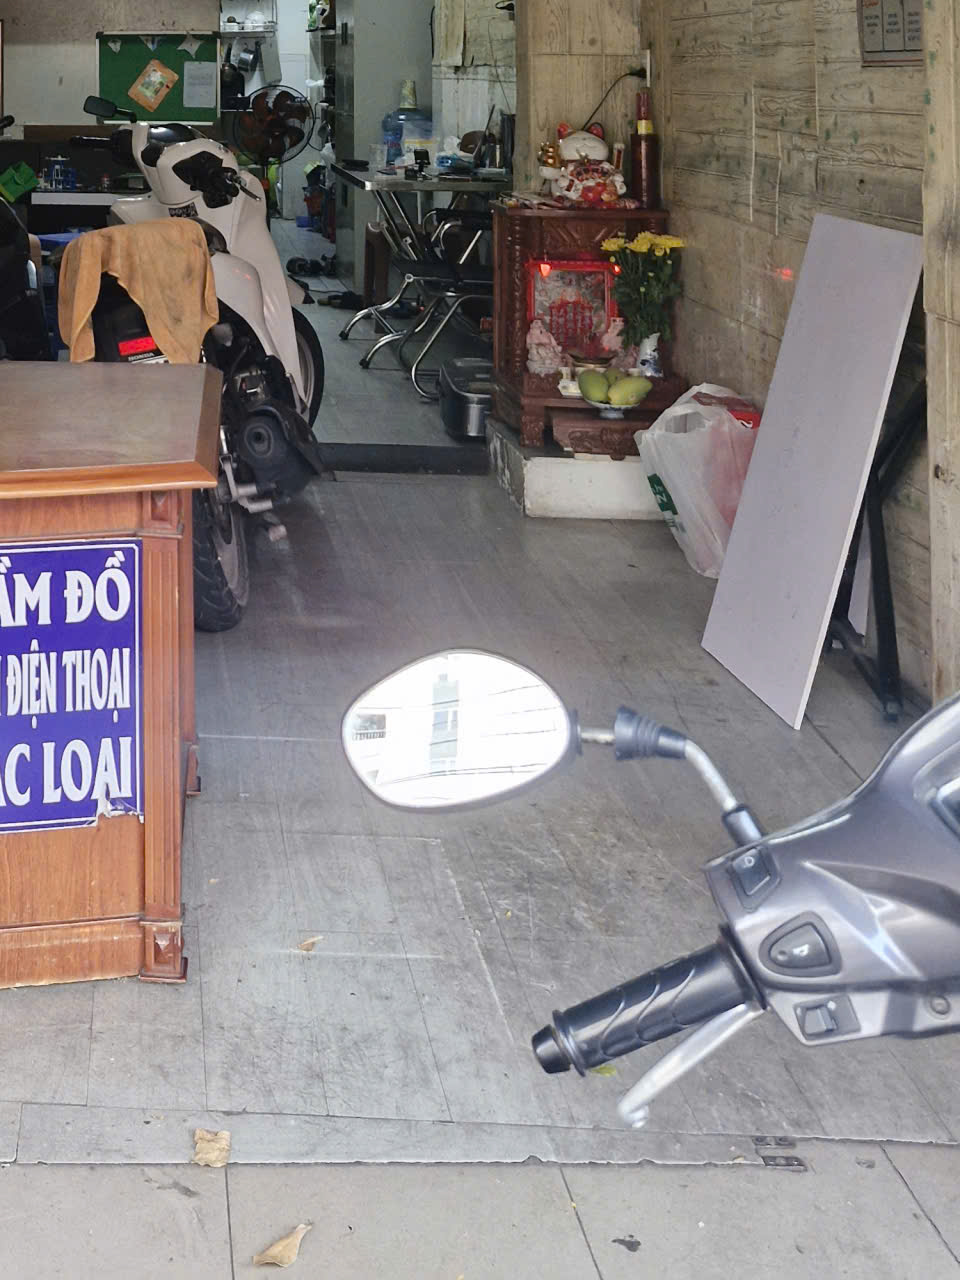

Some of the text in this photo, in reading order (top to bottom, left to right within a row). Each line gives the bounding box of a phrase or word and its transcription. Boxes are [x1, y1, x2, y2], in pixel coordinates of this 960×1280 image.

[63, 550, 132, 624] ĐỒ
[6, 639, 57, 729] ĐIỆN
[62, 648, 131, 723] THOẠI
